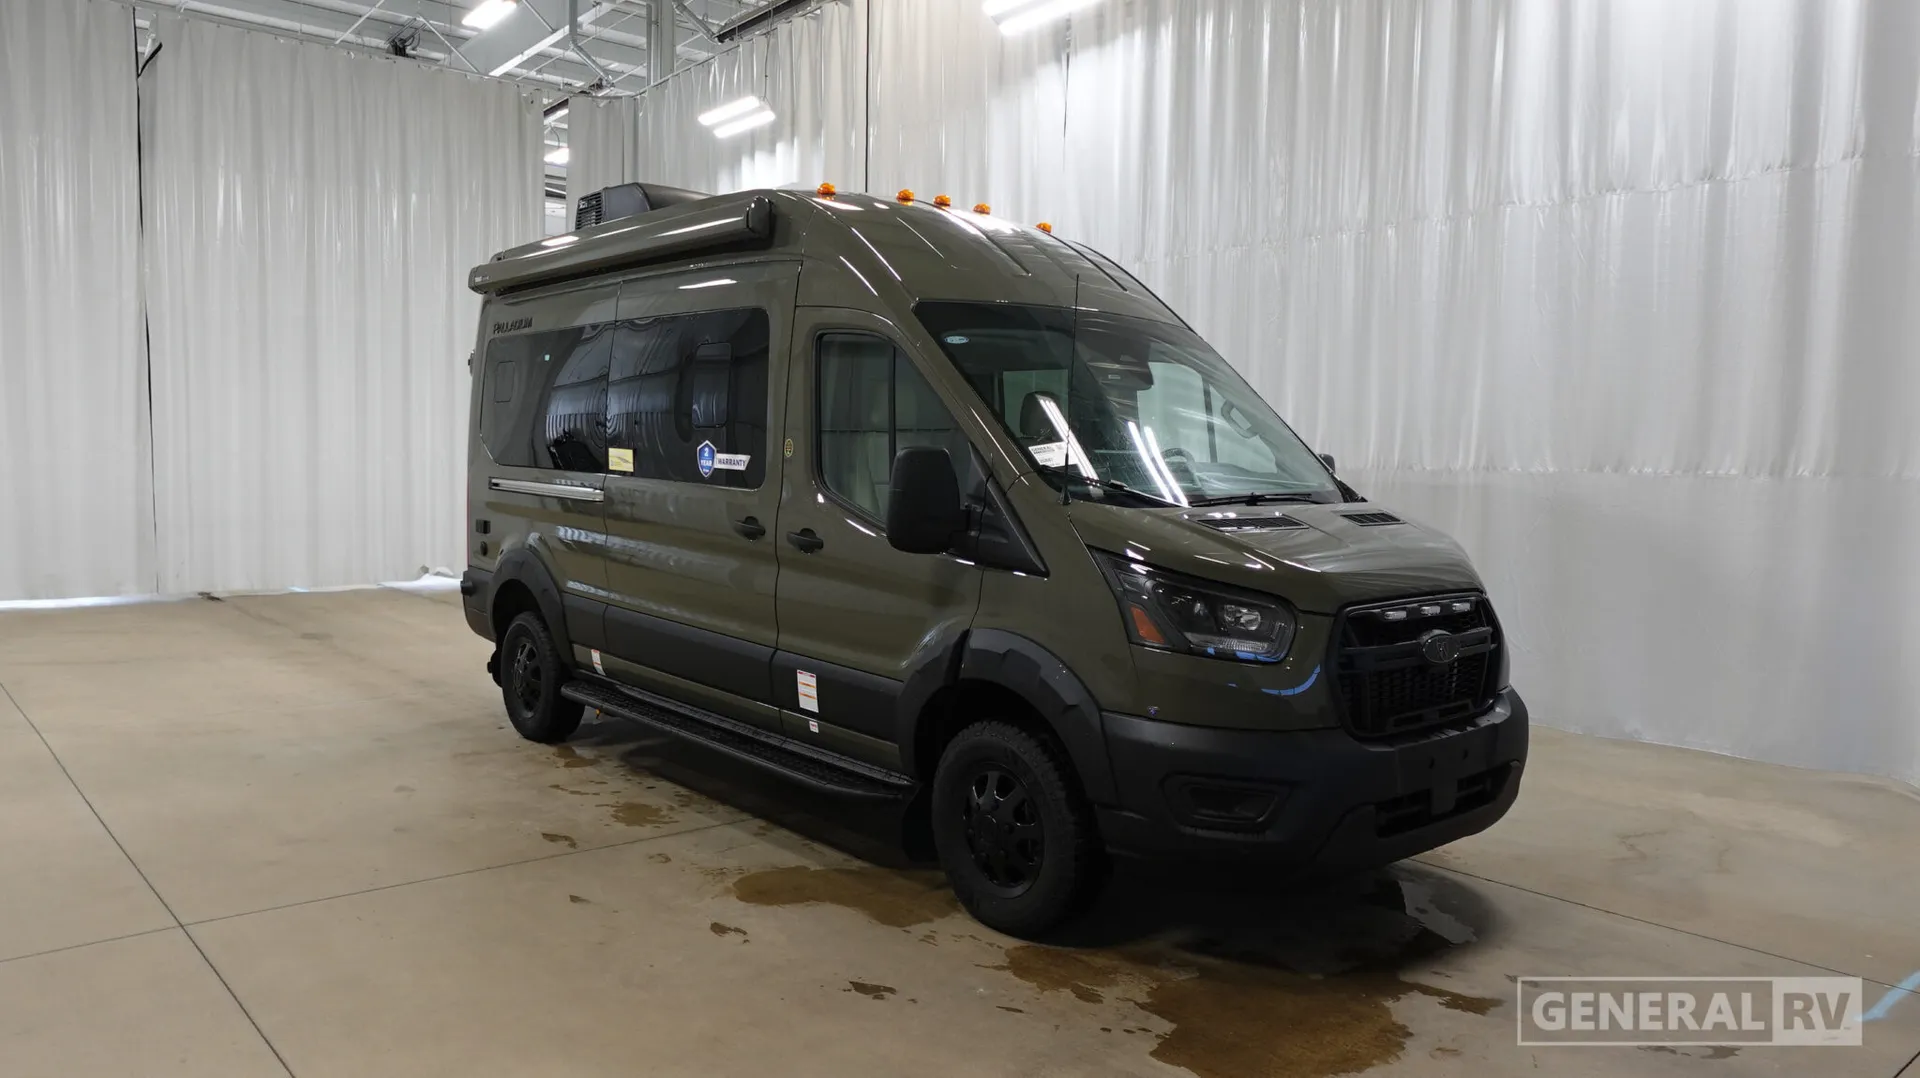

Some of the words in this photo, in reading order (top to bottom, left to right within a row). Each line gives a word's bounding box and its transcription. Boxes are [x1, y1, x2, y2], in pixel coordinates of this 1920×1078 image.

[493, 317, 533, 334] PALLADIUM
[704, 448, 709, 457] 2
[717, 458, 746, 467] WARRANTY
